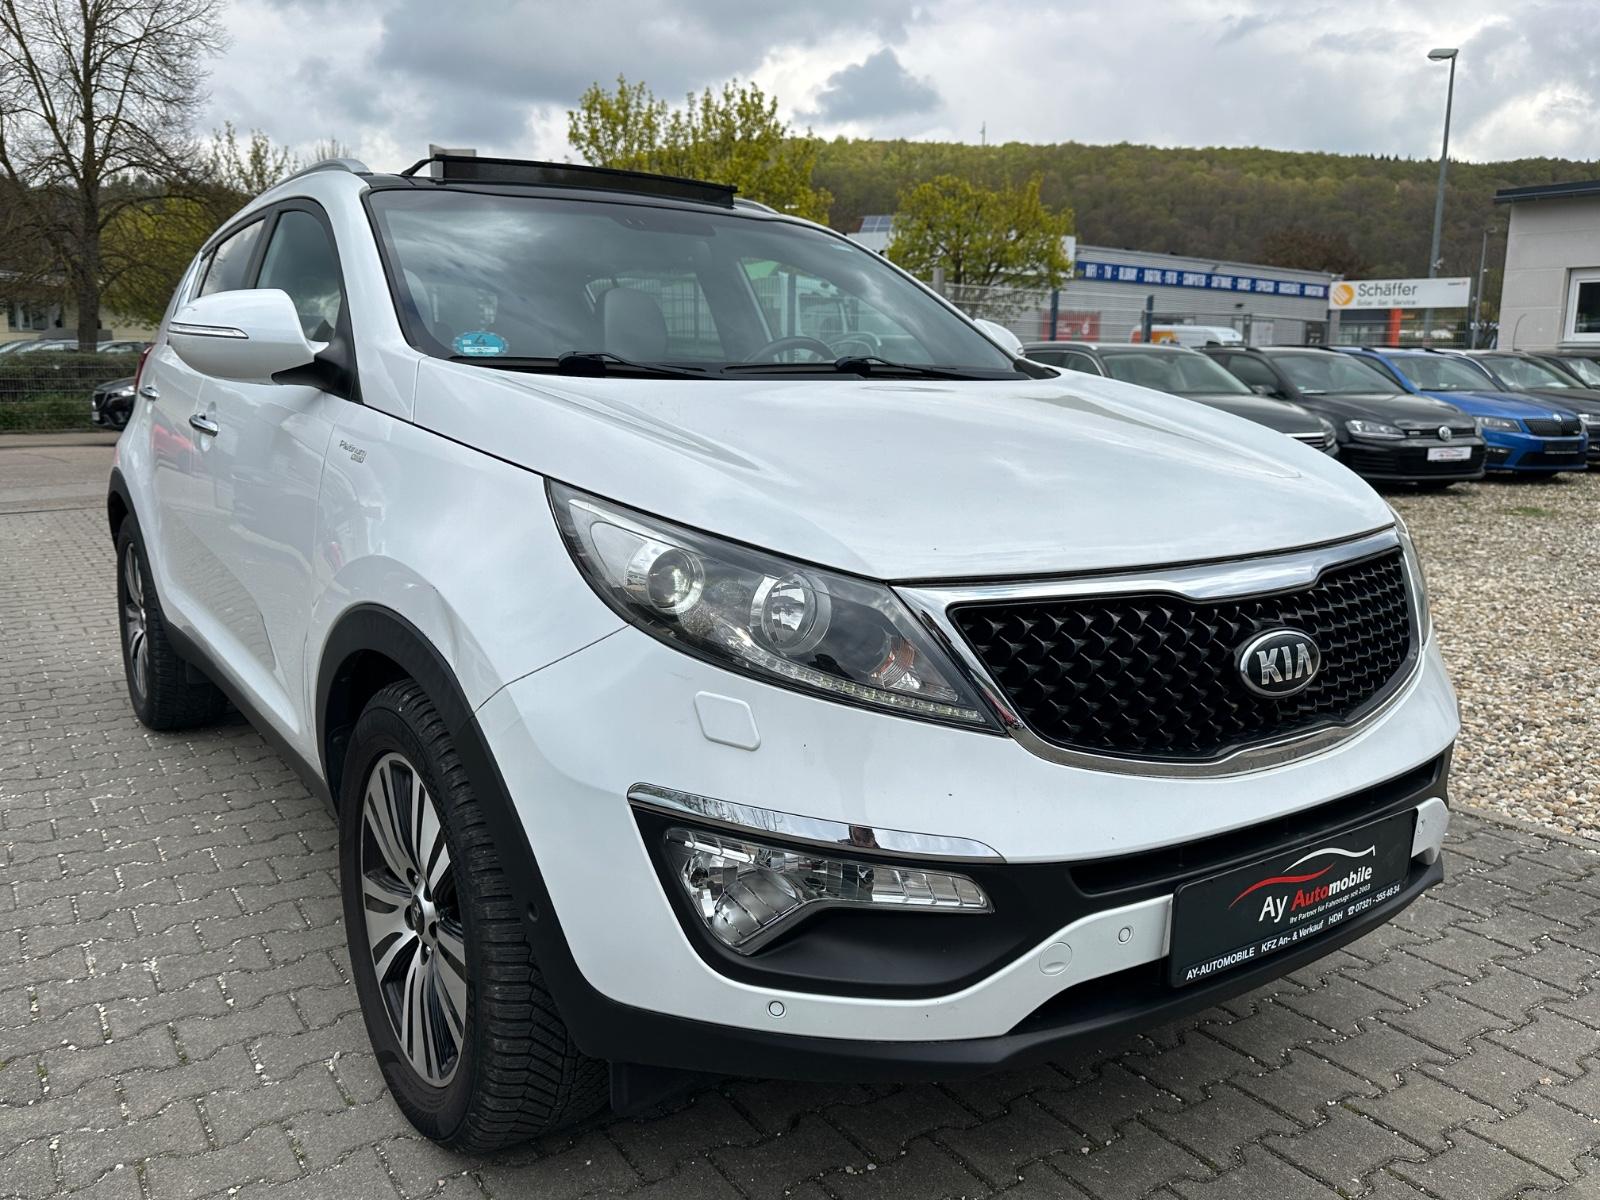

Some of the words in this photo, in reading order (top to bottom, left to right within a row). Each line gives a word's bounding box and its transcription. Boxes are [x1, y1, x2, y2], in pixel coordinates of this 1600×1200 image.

[1358, 282, 1418, 297] Schäffer
[1256, 643, 1313, 685] KIA
[1258, 893, 1288, 923] Ay
[1290, 865, 1372, 911] Automobile
[1289, 916, 1297, 924] Ihr
[1298, 909, 1317, 920] Partner
[1317, 904, 1325, 913] für
[1325, 895, 1350, 910] Fahrzeuge
[1186, 947, 1256, 981] AY-AUTOMOBILE
[1261, 939, 1277, 953] KFZ
[1278, 936, 1291, 947] An-
[1292, 932, 1298, 940] &
[1299, 919, 1325, 938] Verkauf
[1328, 910, 1344, 925] HDH
[1355, 897, 1372, 913] 07321
